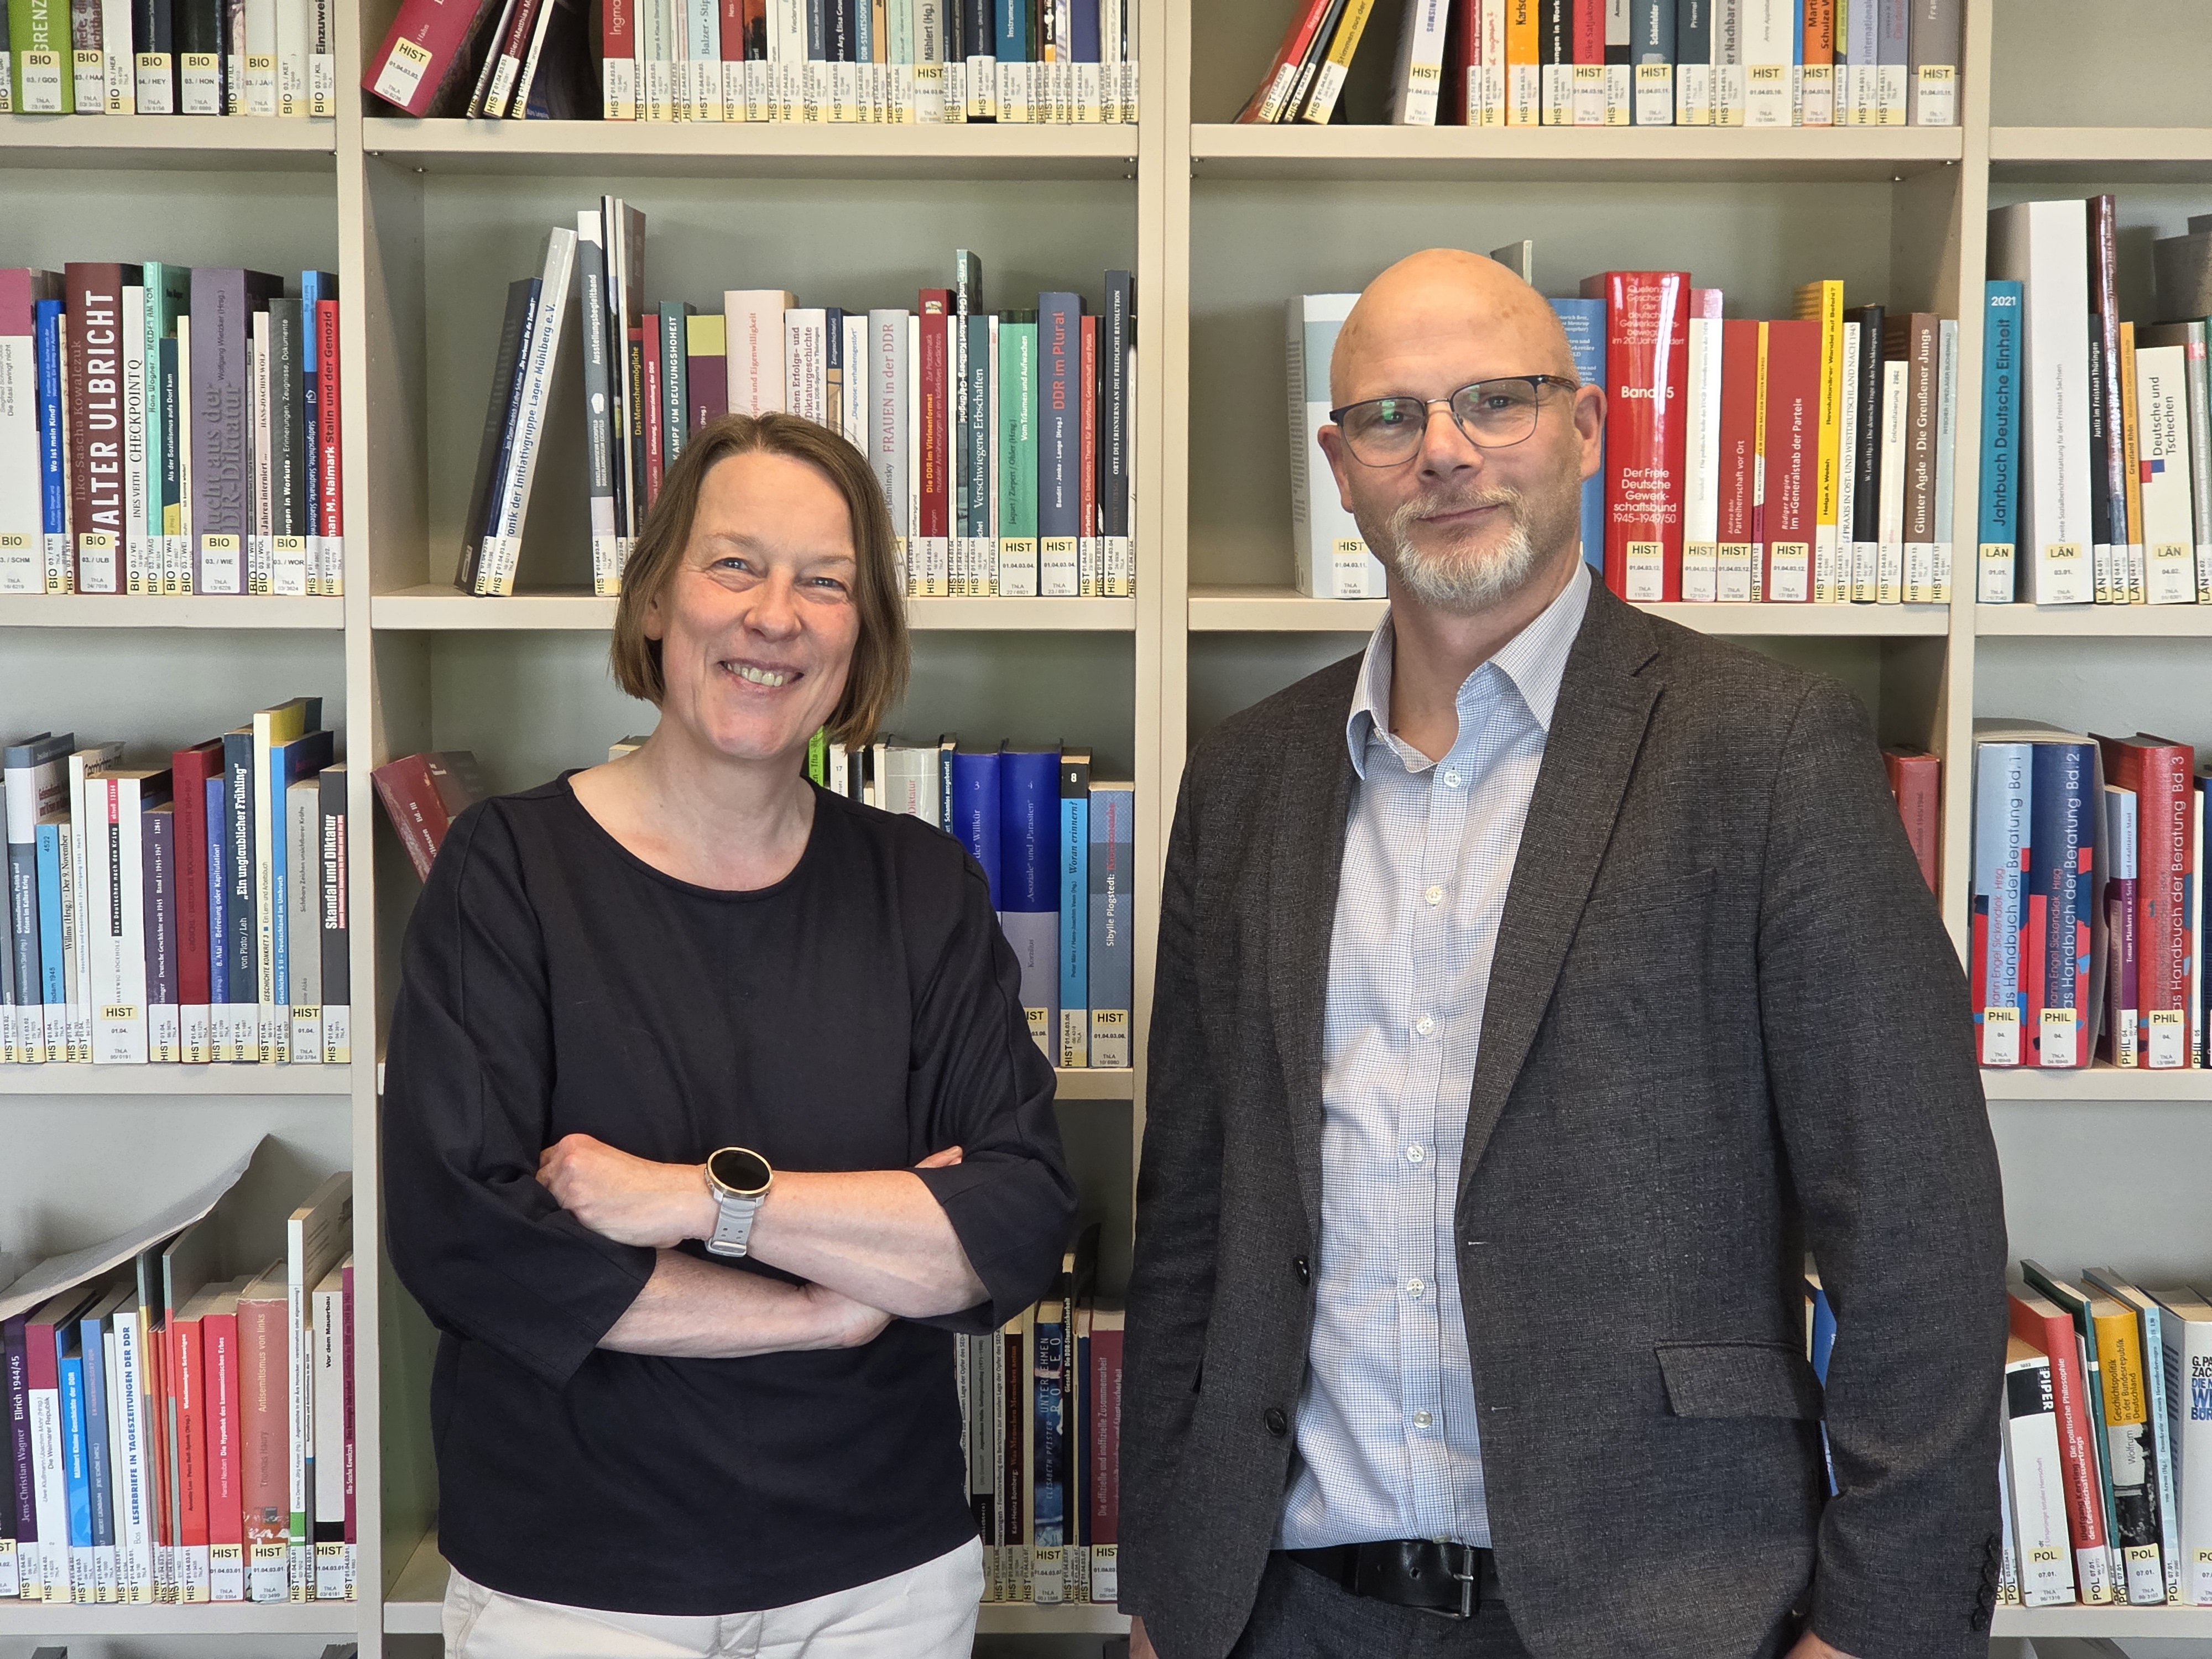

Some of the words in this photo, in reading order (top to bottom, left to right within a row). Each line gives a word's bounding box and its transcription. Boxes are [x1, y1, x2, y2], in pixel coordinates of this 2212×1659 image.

[925, 3, 934, 23] (Hg.)
[701, 25, 710, 55] Balzer
[1725, 7, 1735, 48] Nachbar
[399, 44, 426, 62] HIST
[925, 25, 934, 61] Mählert
[1337, 33, 1353, 65] Stimmen
[30, 55, 51, 64] BIO
[142, 56, 162, 66] BIO
[189, 56, 209, 66] BIO
[918, 69, 943, 78] HIST
[1413, 67, 1439, 78] HIST
[1577, 69, 1601, 77] HIST
[1641, 68, 1667, 77] HIST
[1754, 69, 1779, 78] HIST
[1991, 296, 2016, 307] 2021
[588, 274, 601, 364] Ausstellungsbegleitband
[1052, 311, 1065, 354] Plural
[323, 311, 333, 357] Genozid
[882, 324, 893, 352] DDR
[1918, 329, 1931, 363] Jungs
[1997, 319, 2011, 369] Einheit
[86, 290, 117, 429] ULBRICHT
[533, 327, 553, 374] Mühlberg
[669, 316, 679, 405] DEUTUNGSHOHEIT
[2091, 342, 2101, 375] Thüringen
[71, 340, 83, 415] Kowalczuk
[325, 361, 333, 380] der
[792, 348, 801, 387] Erfolgs-
[805, 327, 813, 418] Diktaturgeschichte
[882, 356, 894, 378] der
[1053, 359, 1065, 375] im
[325, 384, 333, 406] und
[528, 378, 544, 406] Lager
[632, 347, 642, 419] Menschenmögliche
[882, 382, 894, 394] in
[1053, 380, 1065, 409] DDR
[1917, 366, 1928, 427] Greußener
[2149, 377, 2159, 398] und
[974, 369, 984, 429] Erbschaften
[1995, 375, 2008, 447] Deutsche
[128, 372, 142, 462] CHECKPOINT
[325, 410, 334, 442] Stalin
[671, 409, 679, 422] UM
[883, 398, 894, 452] FRAUEN
[2151, 403, 2163, 456] Deutsche
[2164, 397, 2176, 454] Tschechen
[514, 410, 538, 488] Initiativgruppe
[1736, 440, 1745, 453] Ort
[1792, 434, 1801, 450] der
[1916, 430, 1926, 450] Die
[74, 420, 86, 500] Ilko-Sascha
[325, 446, 335, 495] Naimark
[974, 431, 986, 508] Verschwiegene
[1624, 469, 1642, 478] Der
[1645, 468, 1669, 478] Freie
[132, 472, 140, 497] VEITH
[1623, 480, 1671, 489] Deutsche
[1916, 462, 1928, 490] Agde
[1994, 453, 2007, 526] Jahrbuch
[132, 499, 141, 518] INES
[326, 499, 336, 512] M.
[510, 491, 523, 508] der
[1614, 502, 1676, 513] schaftsbund
[1625, 491, 1670, 501] Gewerk-
[1735, 471, 1745, 533] Parteiherrschaft
[1791, 517, 1799, 529] Im
[1914, 494, 1926, 533] Günter
[86, 536, 106, 545] BIO
[209, 538, 229, 547] BIO
[1006, 542, 1032, 552] HIST
[1632, 545, 1658, 554] HIST
[1777, 546, 1803, 555] HIST
[1986, 546, 2008, 558] LÄN
[2158, 546, 2181, 558] LÄN
[1070, 773, 1077, 782] 8
[2008, 766, 2021, 789] Bd.
[2066, 766, 2079, 790] Bd.
[324, 815, 336, 858] Diktatur
[1069, 802, 1078, 843] erinnern?
[2007, 799, 2022, 868] Beratung
[2064, 799, 2081, 868] Beratung
[236, 811, 247, 877] unglaublicher
[325, 862, 336, 882] und
[1068, 846, 1078, 874] Woran
[1106, 874, 1116, 916] Plogstedt:
[2006, 874, 2018, 900] der
[2063, 874, 2077, 900] der
[63, 900, 72, 924] (Hrsg.)
[325, 885, 338, 929] Skandal
[1106, 919, 1115, 946] Sibylle
[2004, 905, 2018, 987] Handbuch
[2062, 905, 2076, 987] Handbuch
[107, 1008, 133, 1017] HIST
[1098, 1014, 1123, 1022] HIST
[1989, 1012, 2014, 1021] PHIL
[2153, 1015, 2178, 1024] PHIL
[257, 1314, 265, 1332] links
[12, 1356, 21, 1390] 1944/45
[1040, 1338, 1049, 1412] UNTERNEHMEN
[2058, 1358, 2070, 1404] Philosophie
[2116, 1338, 2129, 1396] Bundesrepublik
[258, 1352, 267, 1412] Antisemitismus
[2039, 1371, 2054, 1408] PIPER
[2109, 1359, 2122, 1421] Geschichtspolitik
[2129, 1373, 2141, 1418] Deutschland
[13, 1395, 23, 1420] Ellrich
[125, 1371, 137, 1452] TAGESZEITUNGEN
[2125, 1412, 2131, 1421] in
[2064, 1405, 2077, 1443] politische
[17, 1429, 27, 1460] Wagner
[2069, 1446, 2078, 1458] Die
[2126, 1430, 2136, 1464] Wolfrum
[129, 1455, 137, 1464] IN
[19, 1463, 30, 1522] Jens-Christian
[2077, 1437, 2093, 1524] Gesellschaftsvertrags
[131, 1468, 140, 1525] LESERBRIEFE
[213, 1548, 239, 1557] HIST
[1036, 1550, 1061, 1560] HIST
[2034, 1551, 2057, 1561] POL
[2132, 1550, 2154, 1559] POL
